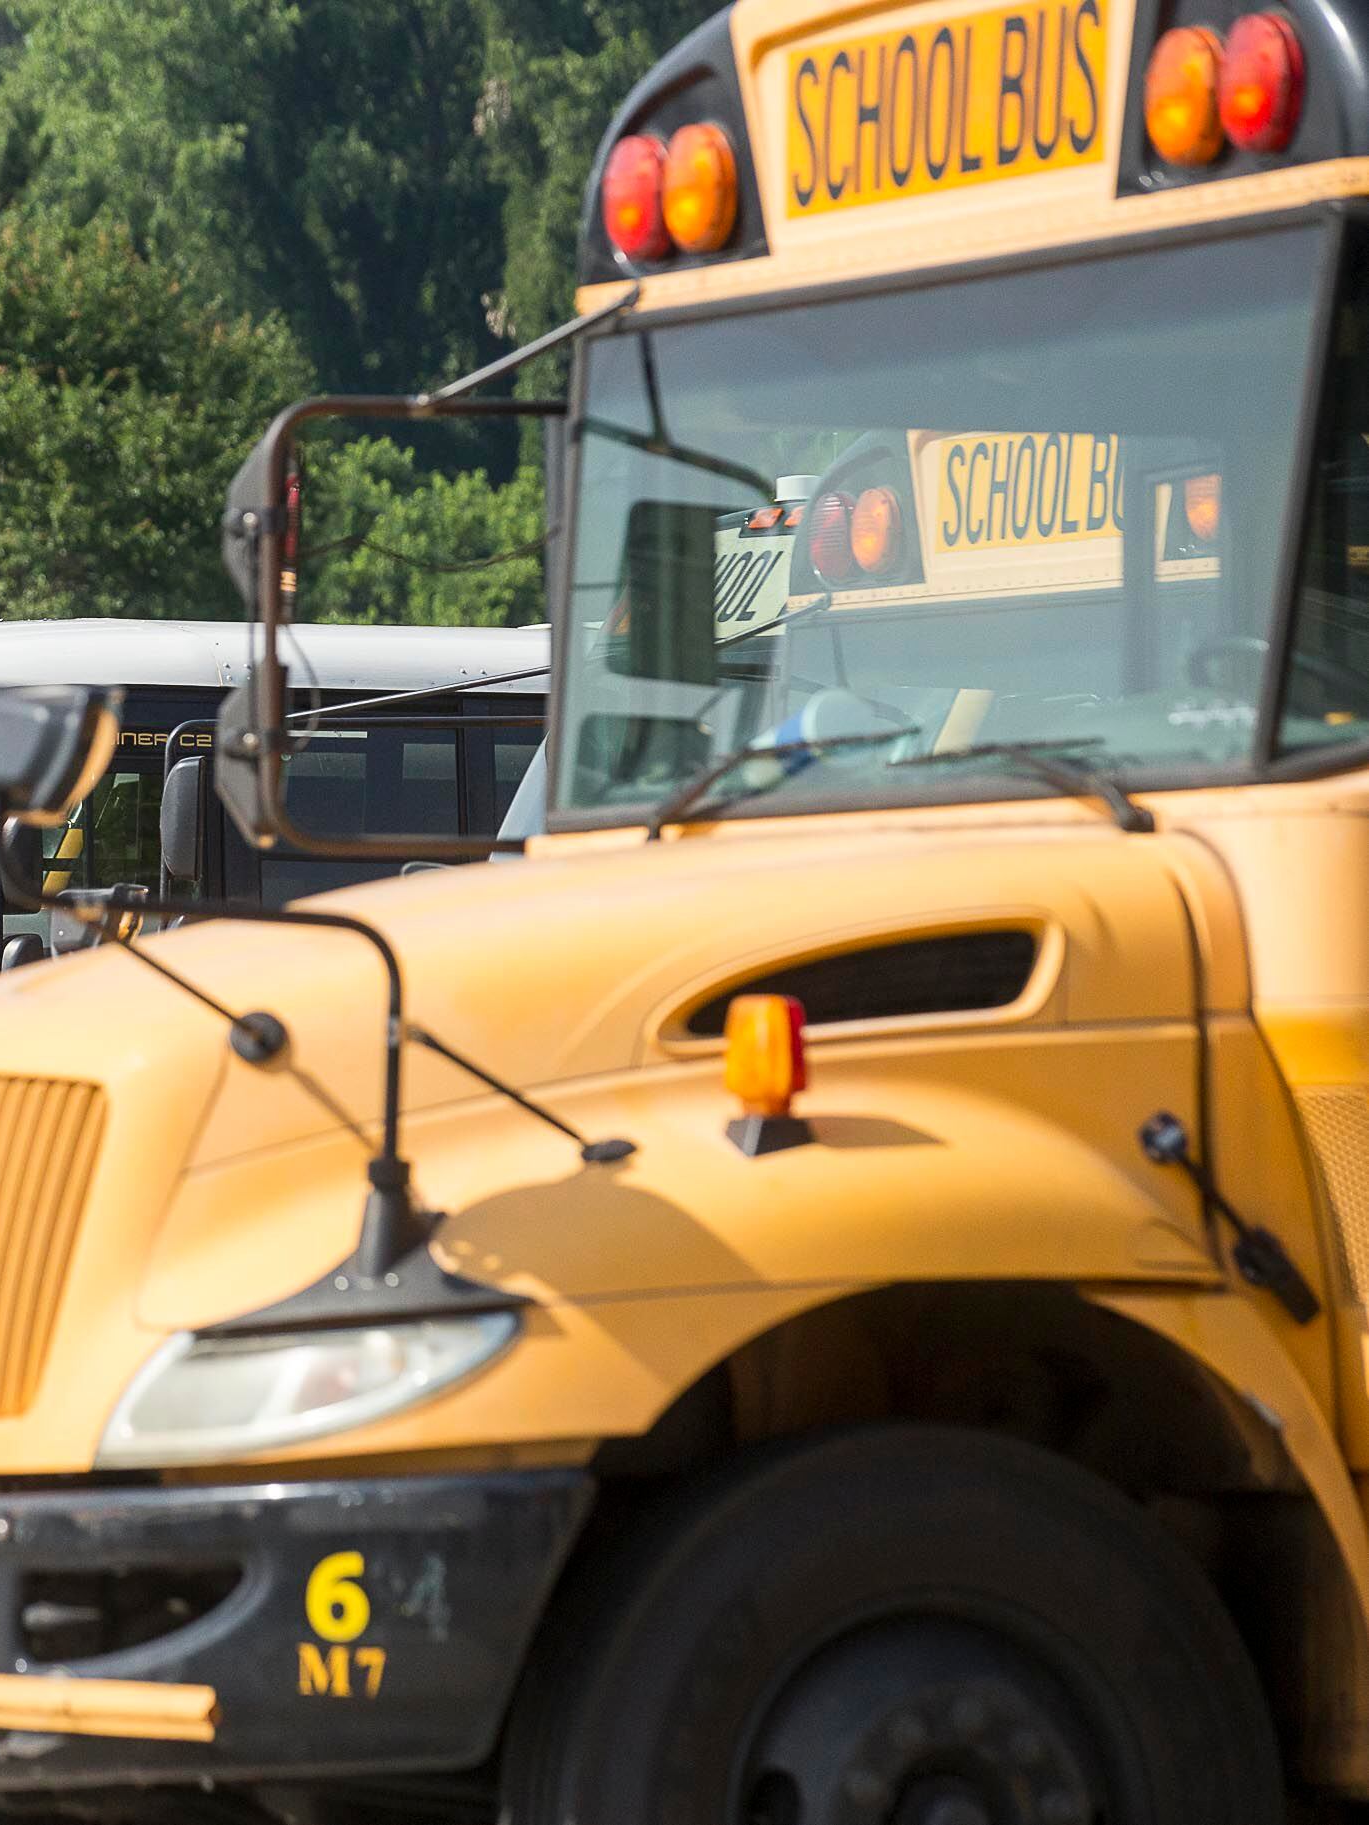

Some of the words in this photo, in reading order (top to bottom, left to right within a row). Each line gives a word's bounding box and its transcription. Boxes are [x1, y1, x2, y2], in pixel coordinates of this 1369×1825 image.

[793, 26, 983, 208] SCHOOL
[997, 0, 1100, 167] BUS
[942, 432, 1079, 547] SCHOOL
[179, 733, 212, 747] C2
[305, 1550, 371, 1643] 6
